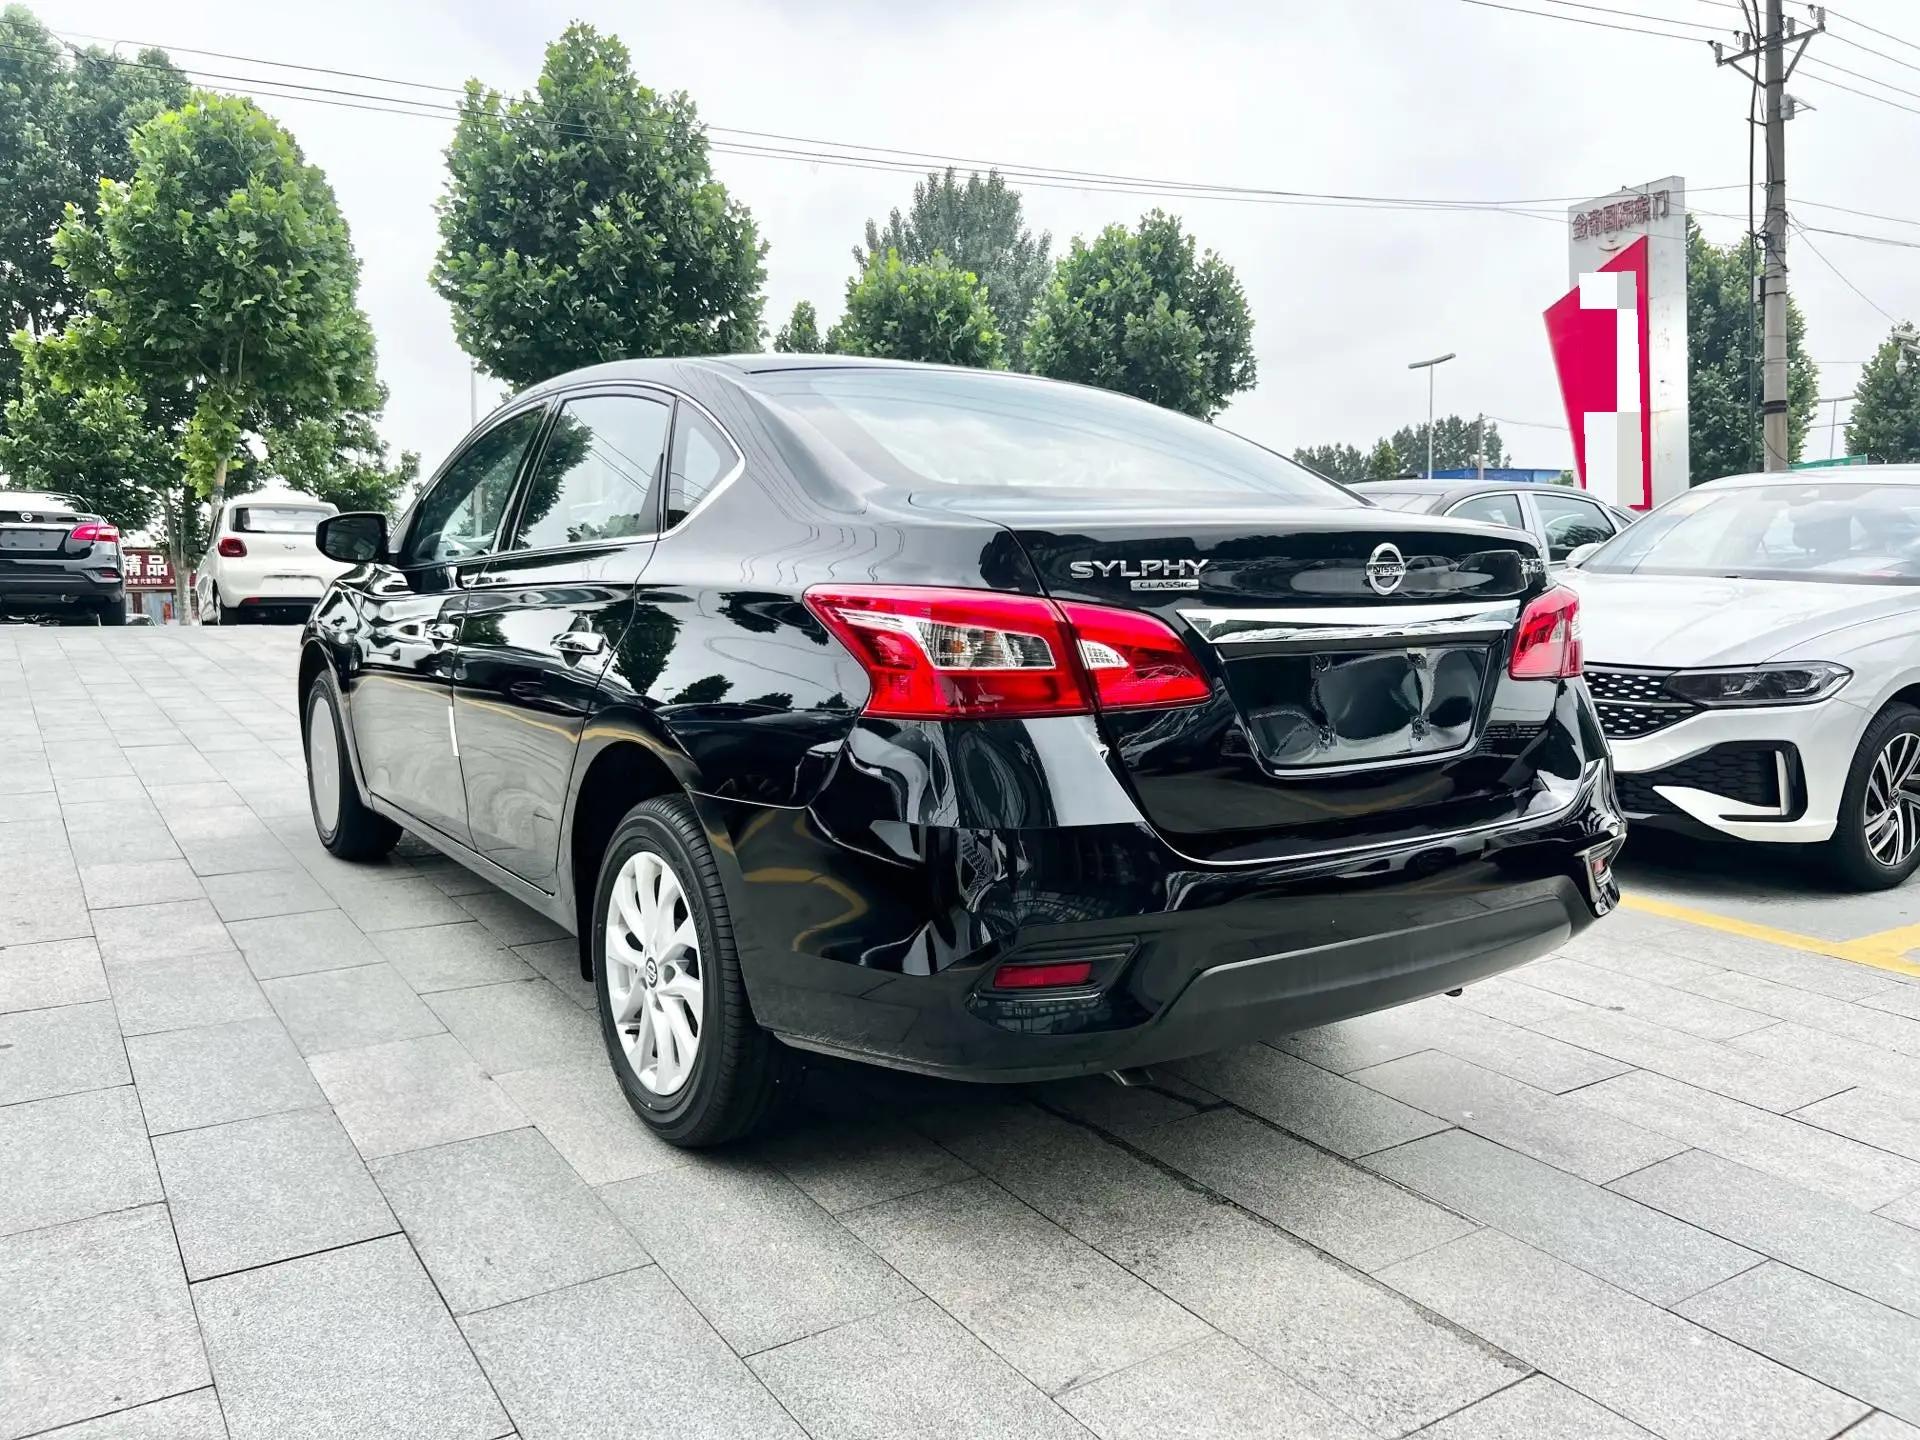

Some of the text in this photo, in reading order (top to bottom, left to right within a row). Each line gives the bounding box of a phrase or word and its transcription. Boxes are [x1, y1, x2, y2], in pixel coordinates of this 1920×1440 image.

[1070, 559, 1209, 578] SYLPHY
[1369, 564, 1405, 575] NISSAN
[1139, 581, 1192, 589] CLASSIC
